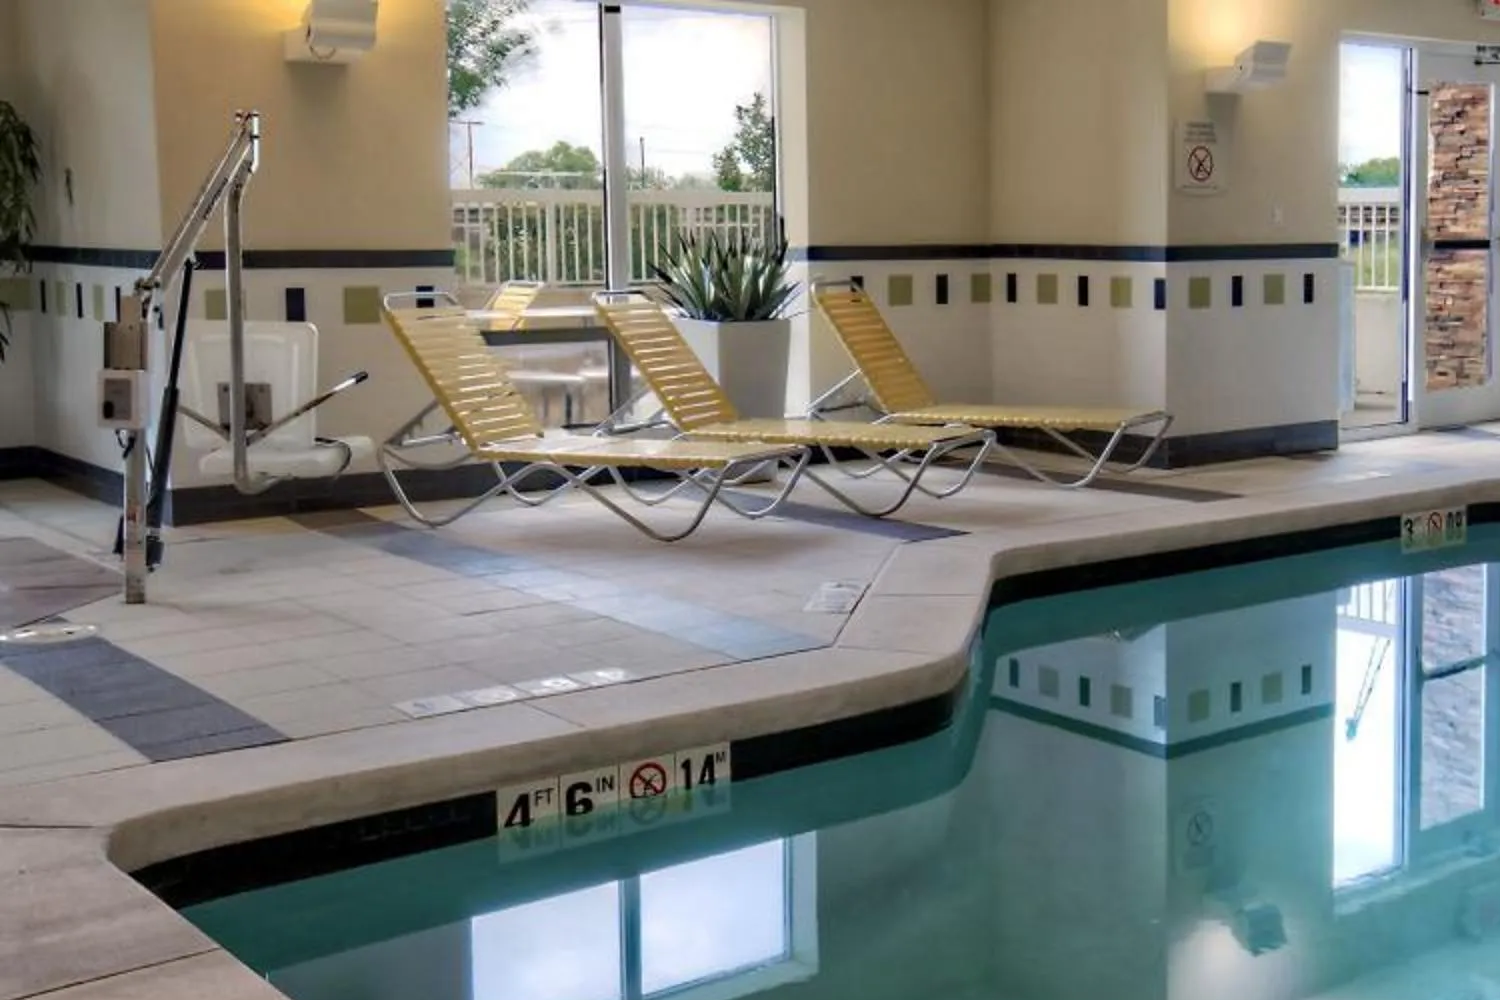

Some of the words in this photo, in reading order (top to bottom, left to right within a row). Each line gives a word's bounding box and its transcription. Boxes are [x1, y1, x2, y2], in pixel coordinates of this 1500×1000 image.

[504, 793, 534, 828] 4
[534, 787, 555, 806] FT
[566, 781, 593, 816] 6
[596, 774, 615, 795] IN
